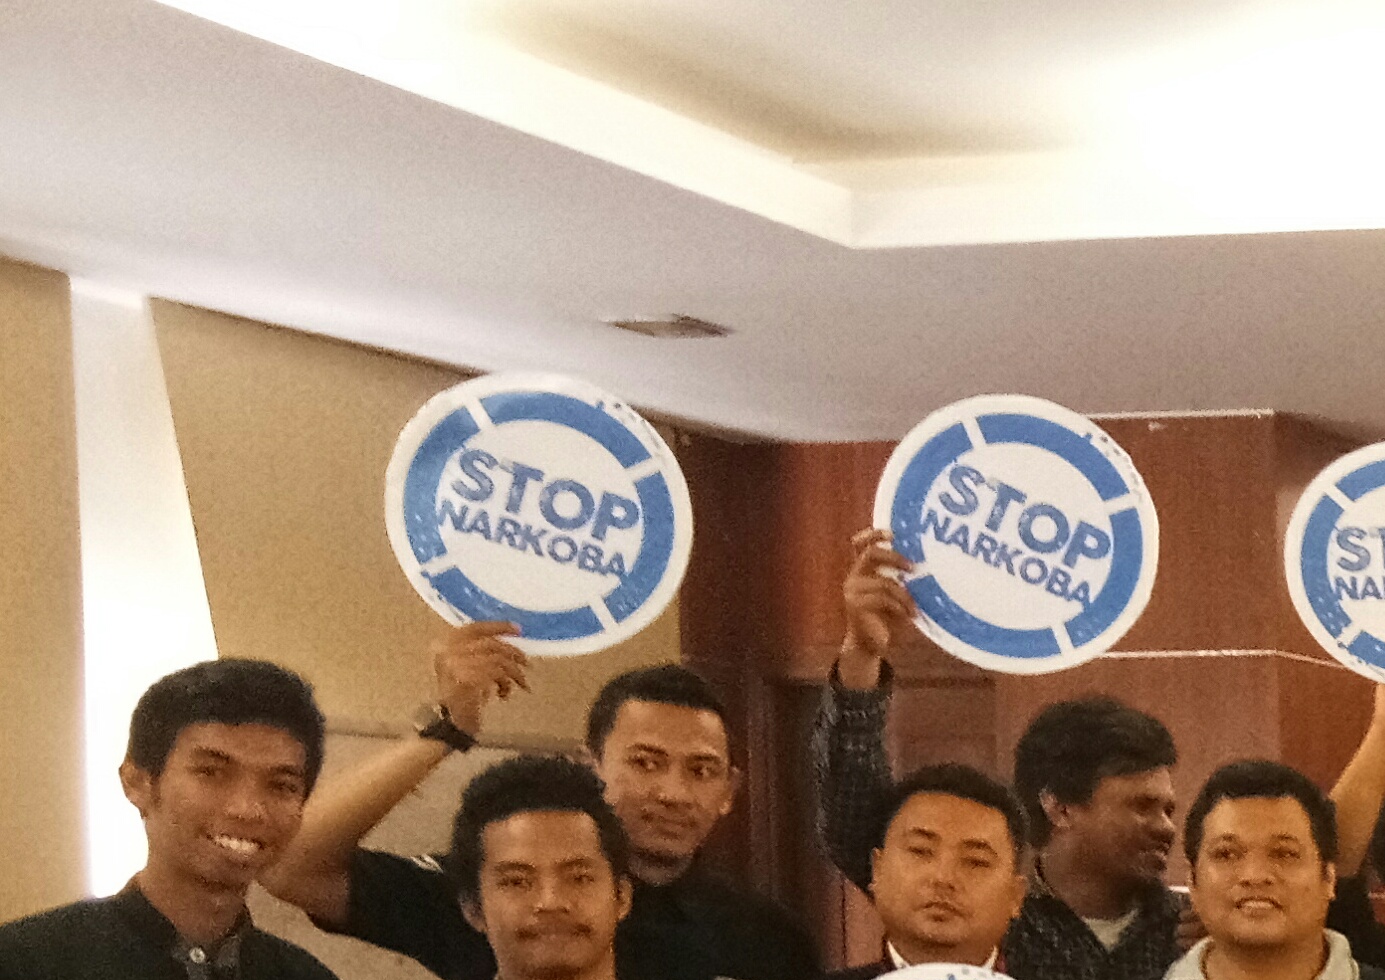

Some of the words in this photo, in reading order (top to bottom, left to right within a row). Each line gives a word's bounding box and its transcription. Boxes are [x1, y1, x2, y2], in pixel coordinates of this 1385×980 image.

[437, 500, 628, 578] NARKOBA
[450, 449, 639, 539] STOP
[939, 467, 1110, 566] STOP
[921, 511, 1092, 604] NARKOBA
